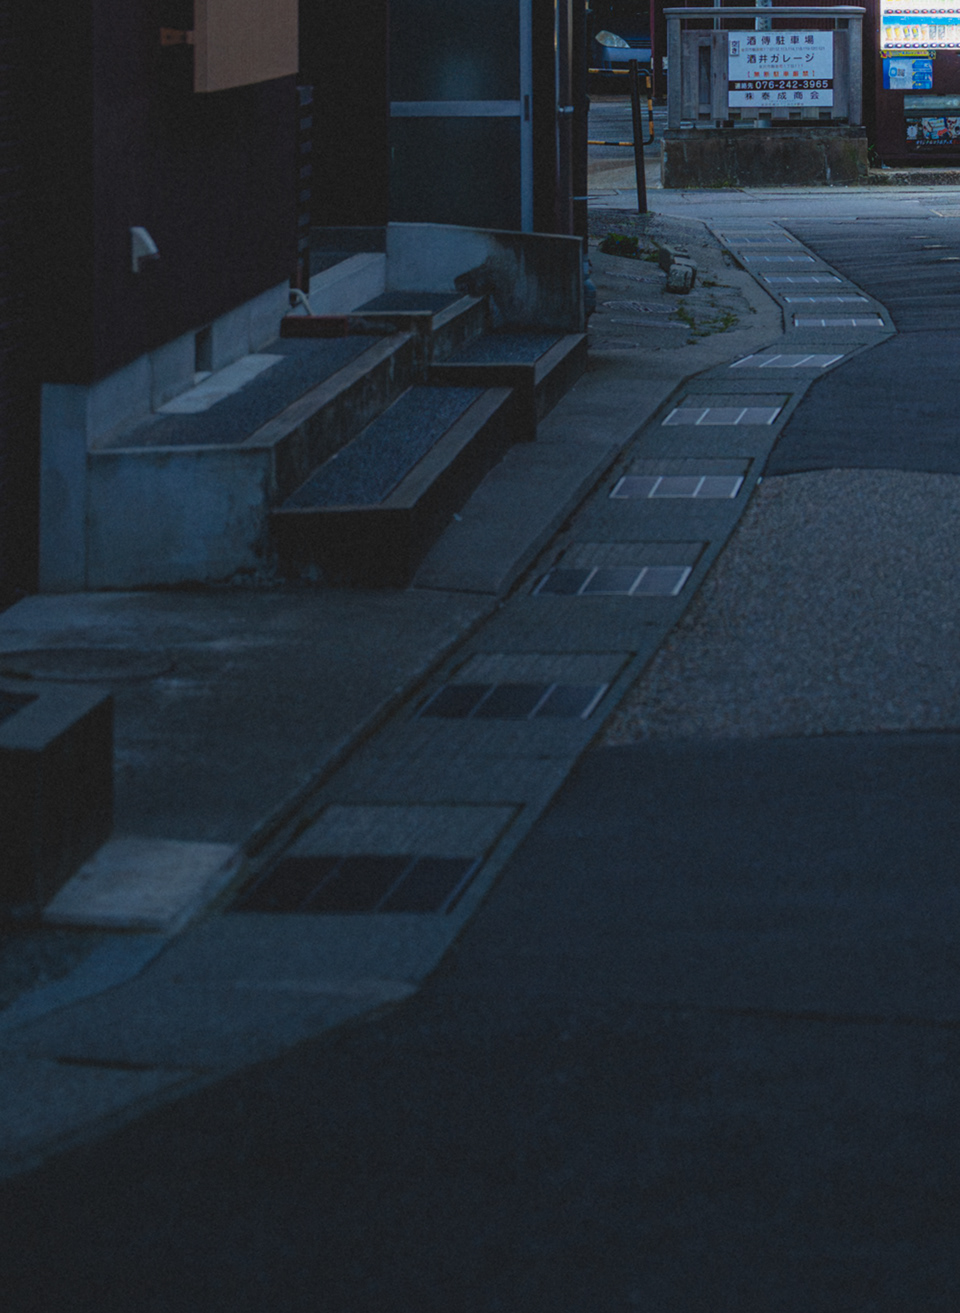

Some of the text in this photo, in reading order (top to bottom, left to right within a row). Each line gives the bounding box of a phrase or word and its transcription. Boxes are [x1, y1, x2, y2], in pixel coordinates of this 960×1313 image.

[746, 53, 815, 64] 酒井ガレージ
[755, 80, 829, 90] 076-242-3965
